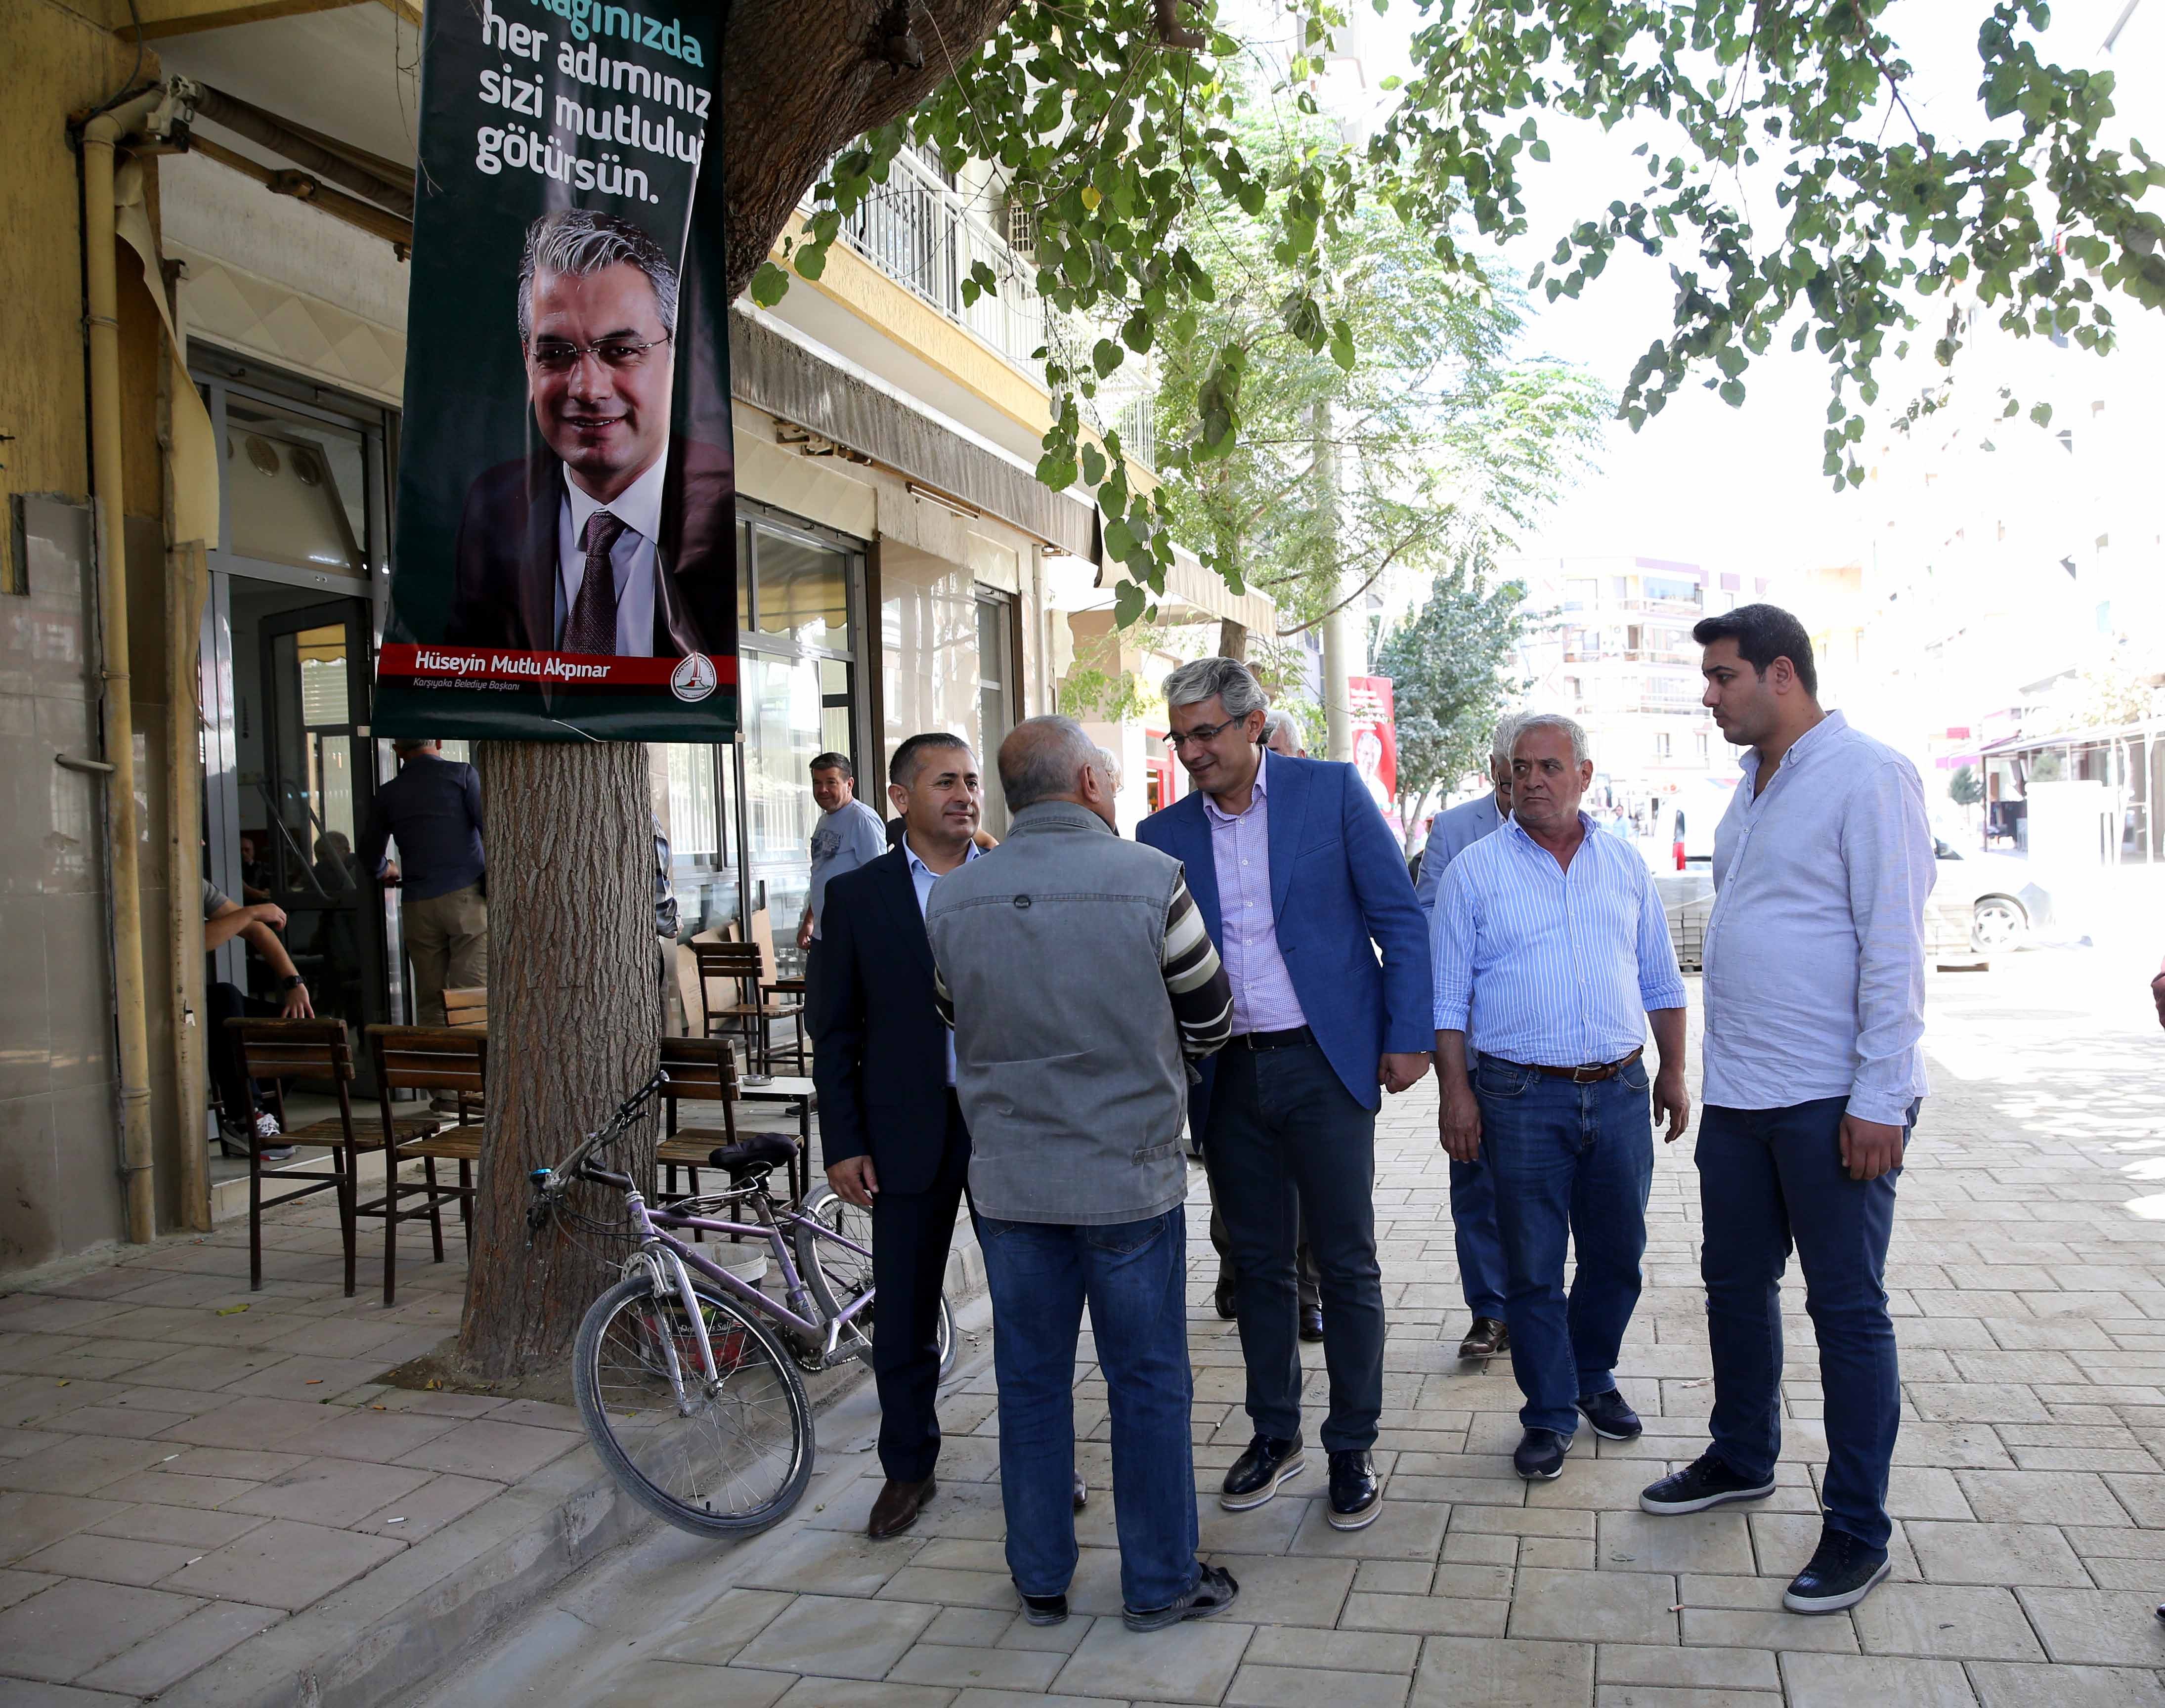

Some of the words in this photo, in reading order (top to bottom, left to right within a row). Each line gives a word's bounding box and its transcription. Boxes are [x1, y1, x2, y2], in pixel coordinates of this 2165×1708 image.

[482, 0, 549, 62] her
[557, 42, 711, 120] adımınız
[478, 63, 544, 118] sizi
[476, 122, 659, 204] götürsün.
[413, 678, 452, 689] Karşıyaka
[454, 679, 487, 690] Belediye
[488, 681, 520, 691] Başkanı
[415, 650, 486, 675] Hüseyin
[490, 655, 541, 675] Mutlu
[544, 657, 611, 681] Akpınar
